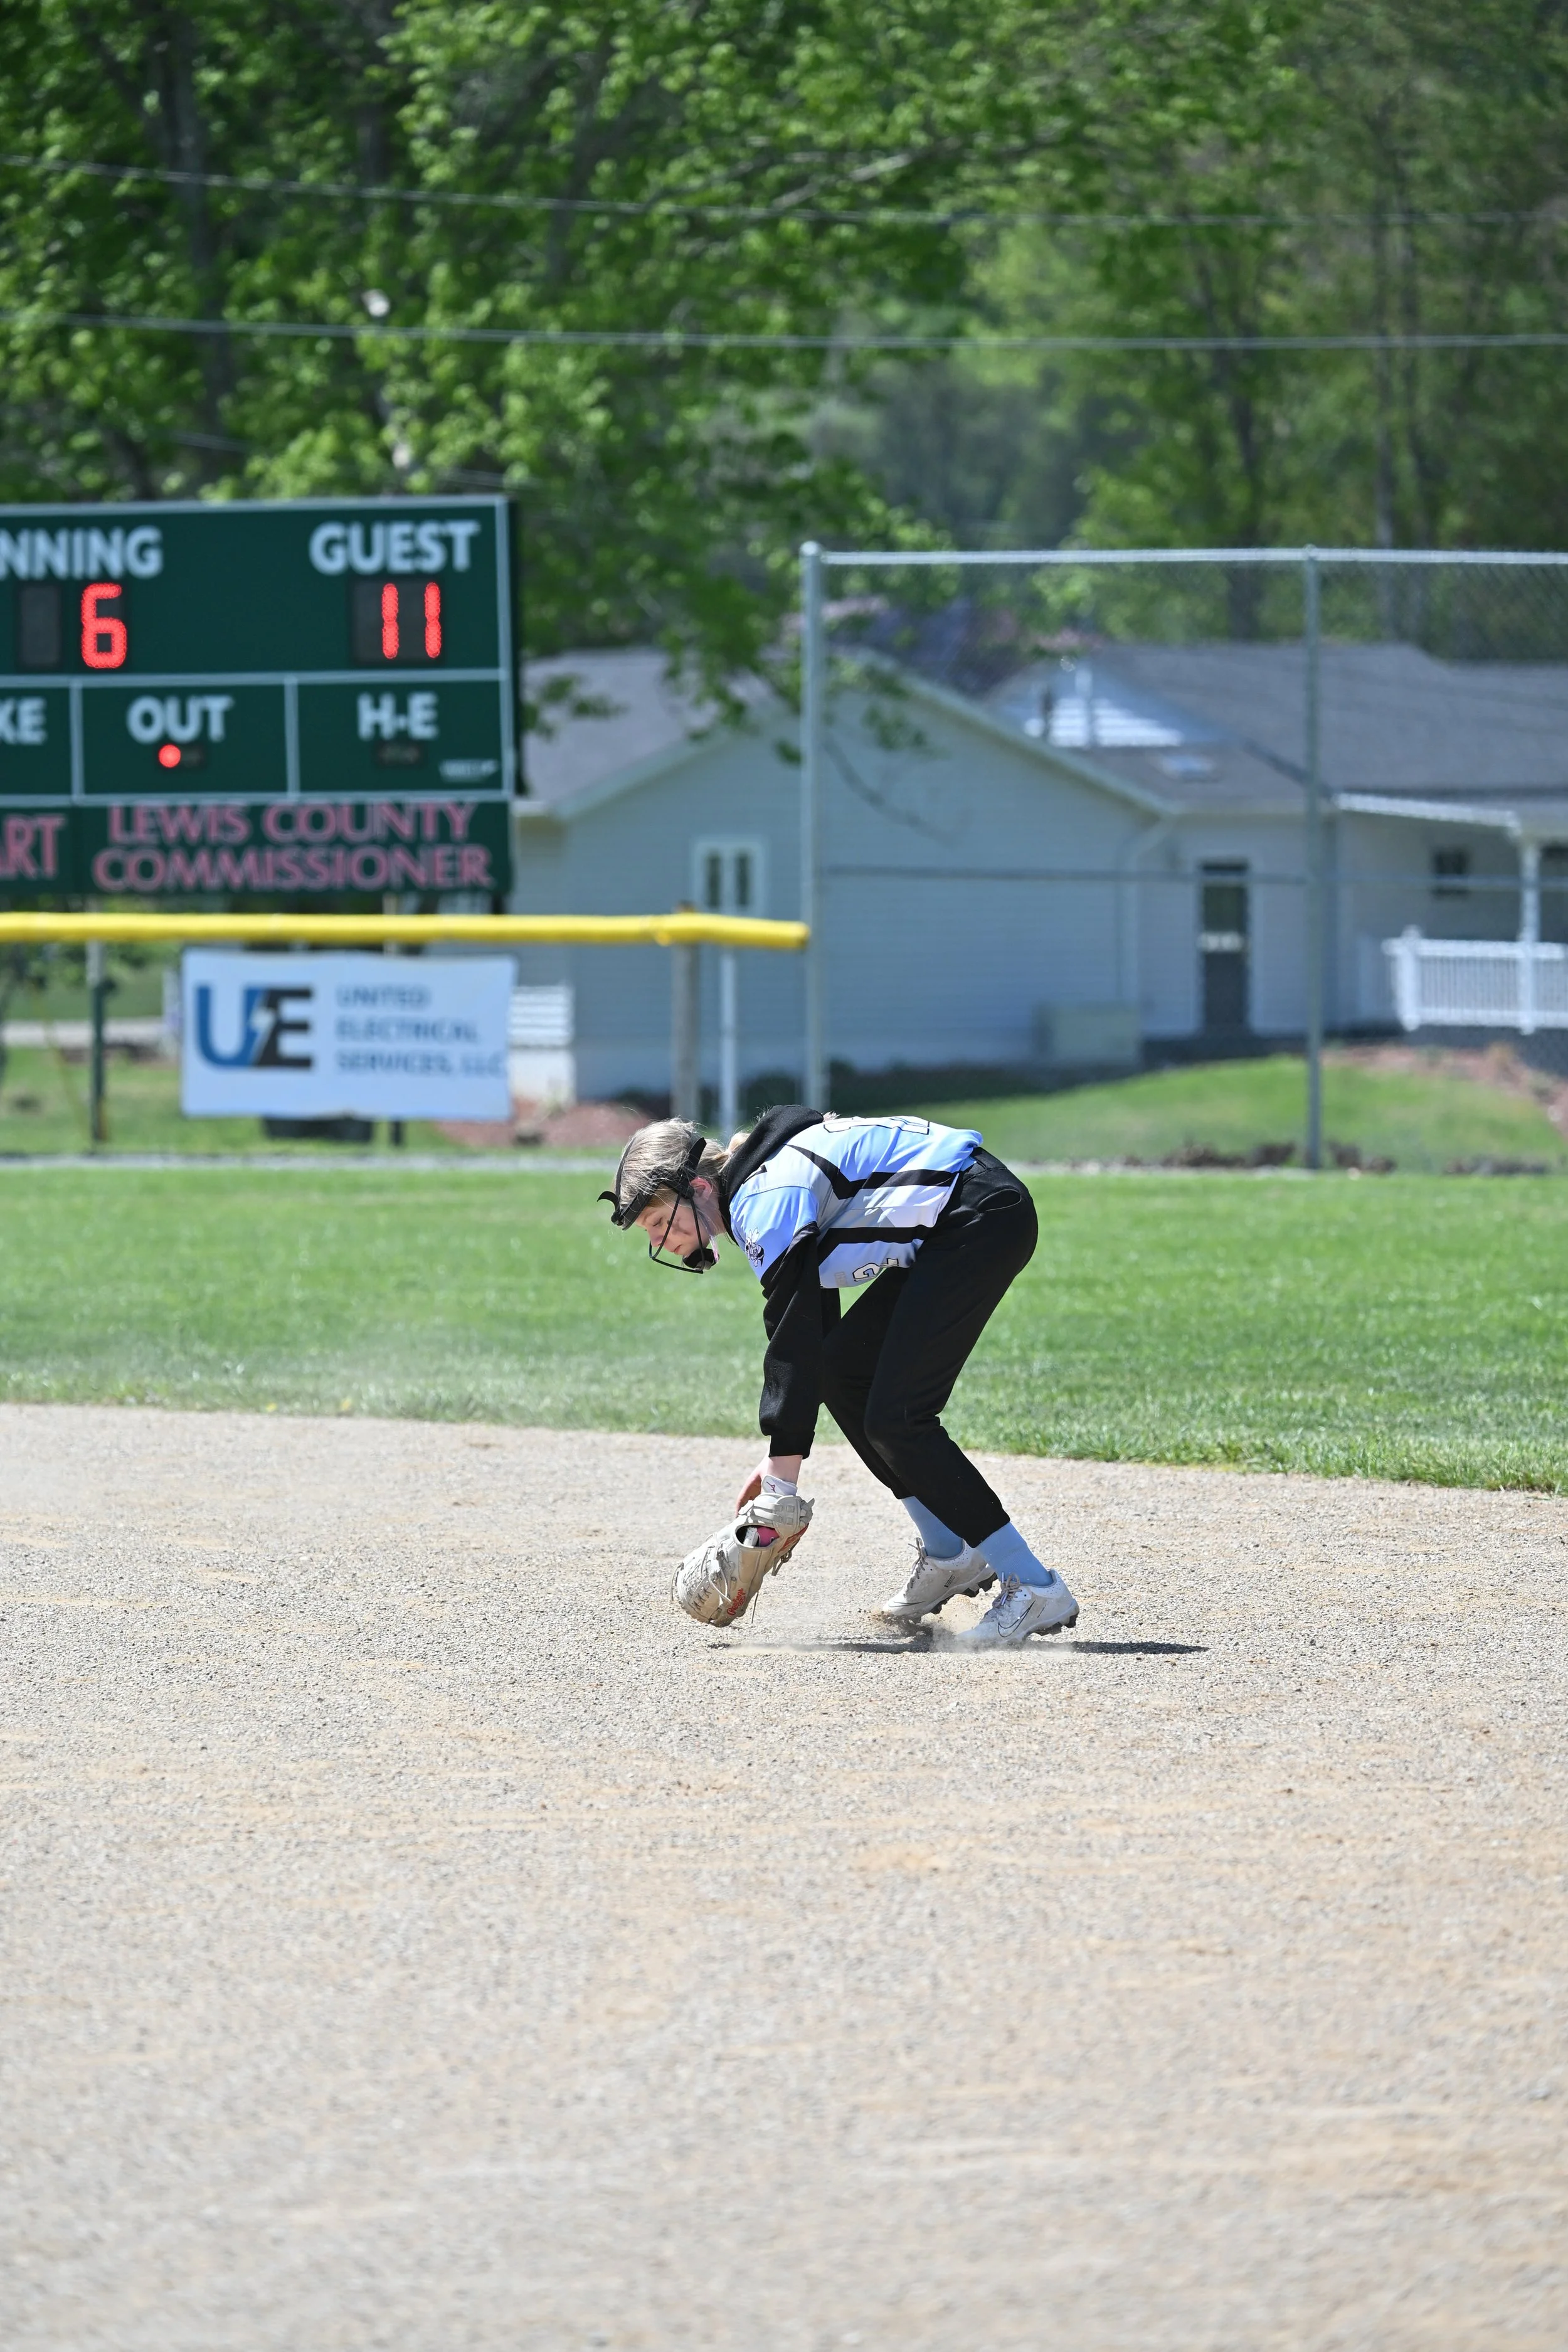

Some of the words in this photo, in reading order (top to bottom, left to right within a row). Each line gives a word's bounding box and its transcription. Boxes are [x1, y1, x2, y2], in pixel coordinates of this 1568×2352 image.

[310, 521, 480, 575] GUEST
[81, 583, 127, 669] 6
[382, 583, 442, 659] 11
[128, 695, 232, 743] OUT
[109, 803, 250, 844] LEWIS
[263, 800, 477, 842] COUNTY
[0, 813, 66, 880] RT
[93, 845, 491, 891] COMMISSIONER
[336, 985, 432, 1011] UNITED
[336, 1017, 479, 1046] ELECTRICAL
